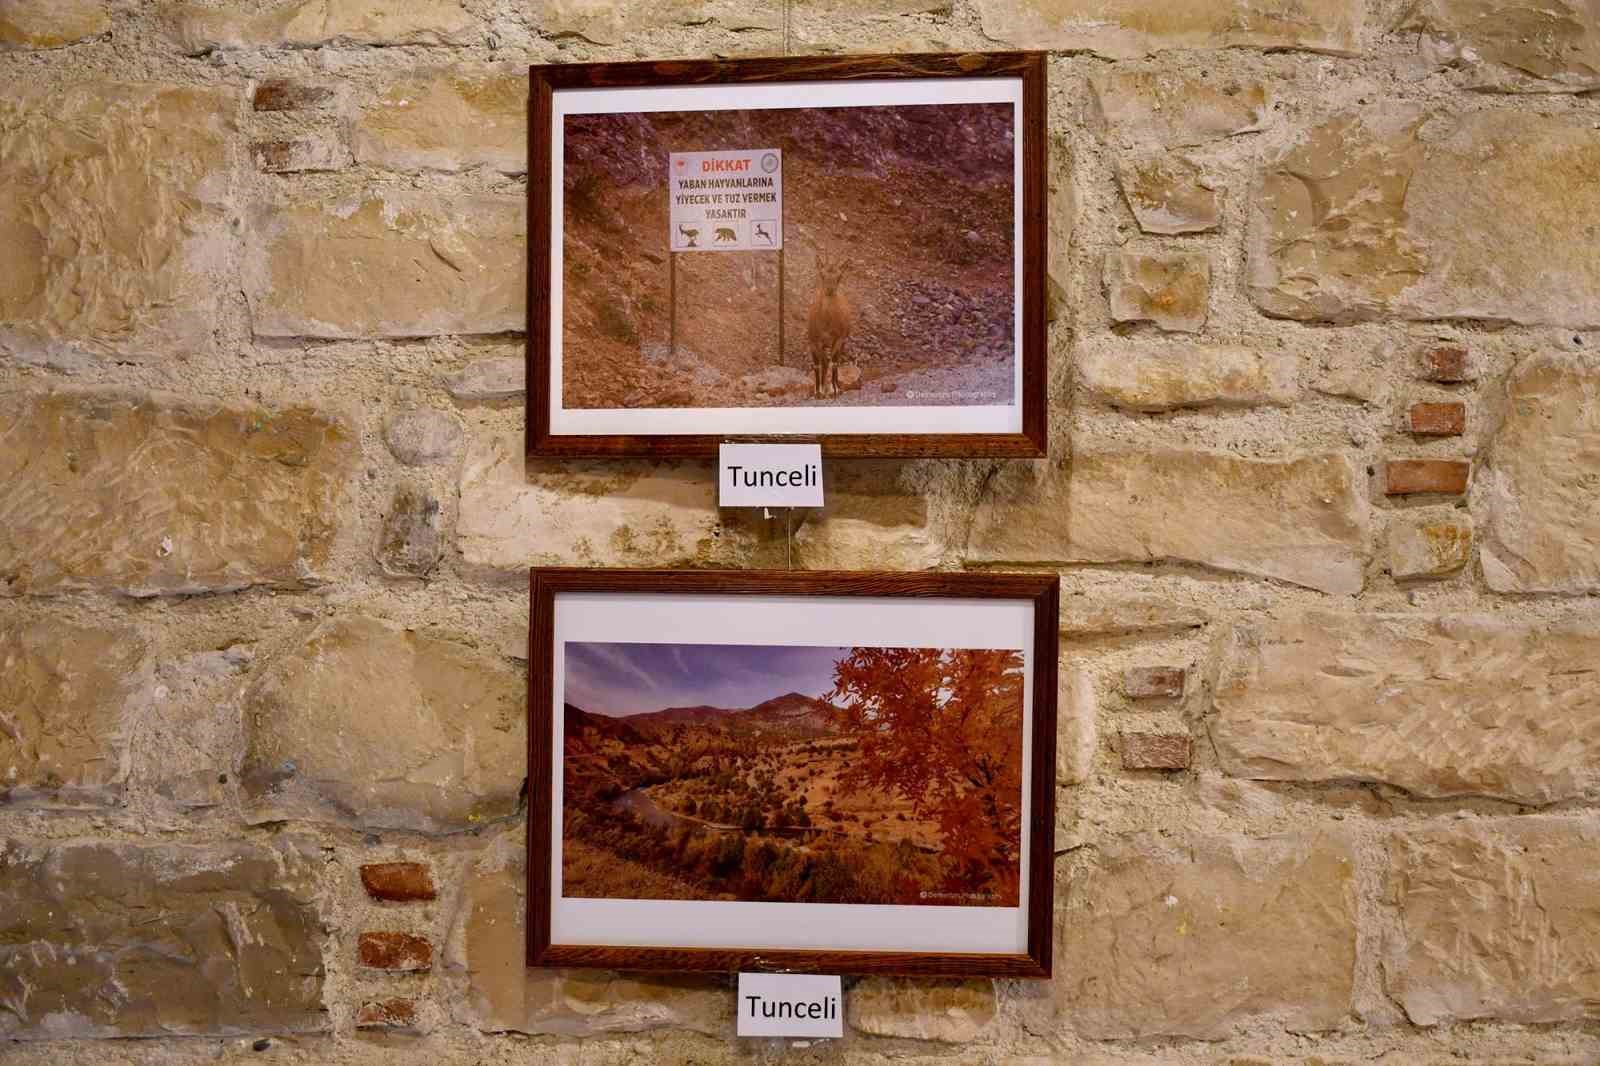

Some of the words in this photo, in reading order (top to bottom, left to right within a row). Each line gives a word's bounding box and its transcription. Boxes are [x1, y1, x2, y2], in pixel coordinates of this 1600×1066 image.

[702, 158, 752, 172] DİKKAT
[678, 180, 706, 190] YABAN
[708, 177, 774, 189] HAYVANLARINA
[712, 194, 722, 204] VE
[724, 194, 740, 204] TUZ
[742, 193, 777, 203] VERMEK
[705, 209, 746, 219] YASAKTIR
[727, 464, 816, 487] Tunceli
[745, 996, 836, 1020] Tunceli
